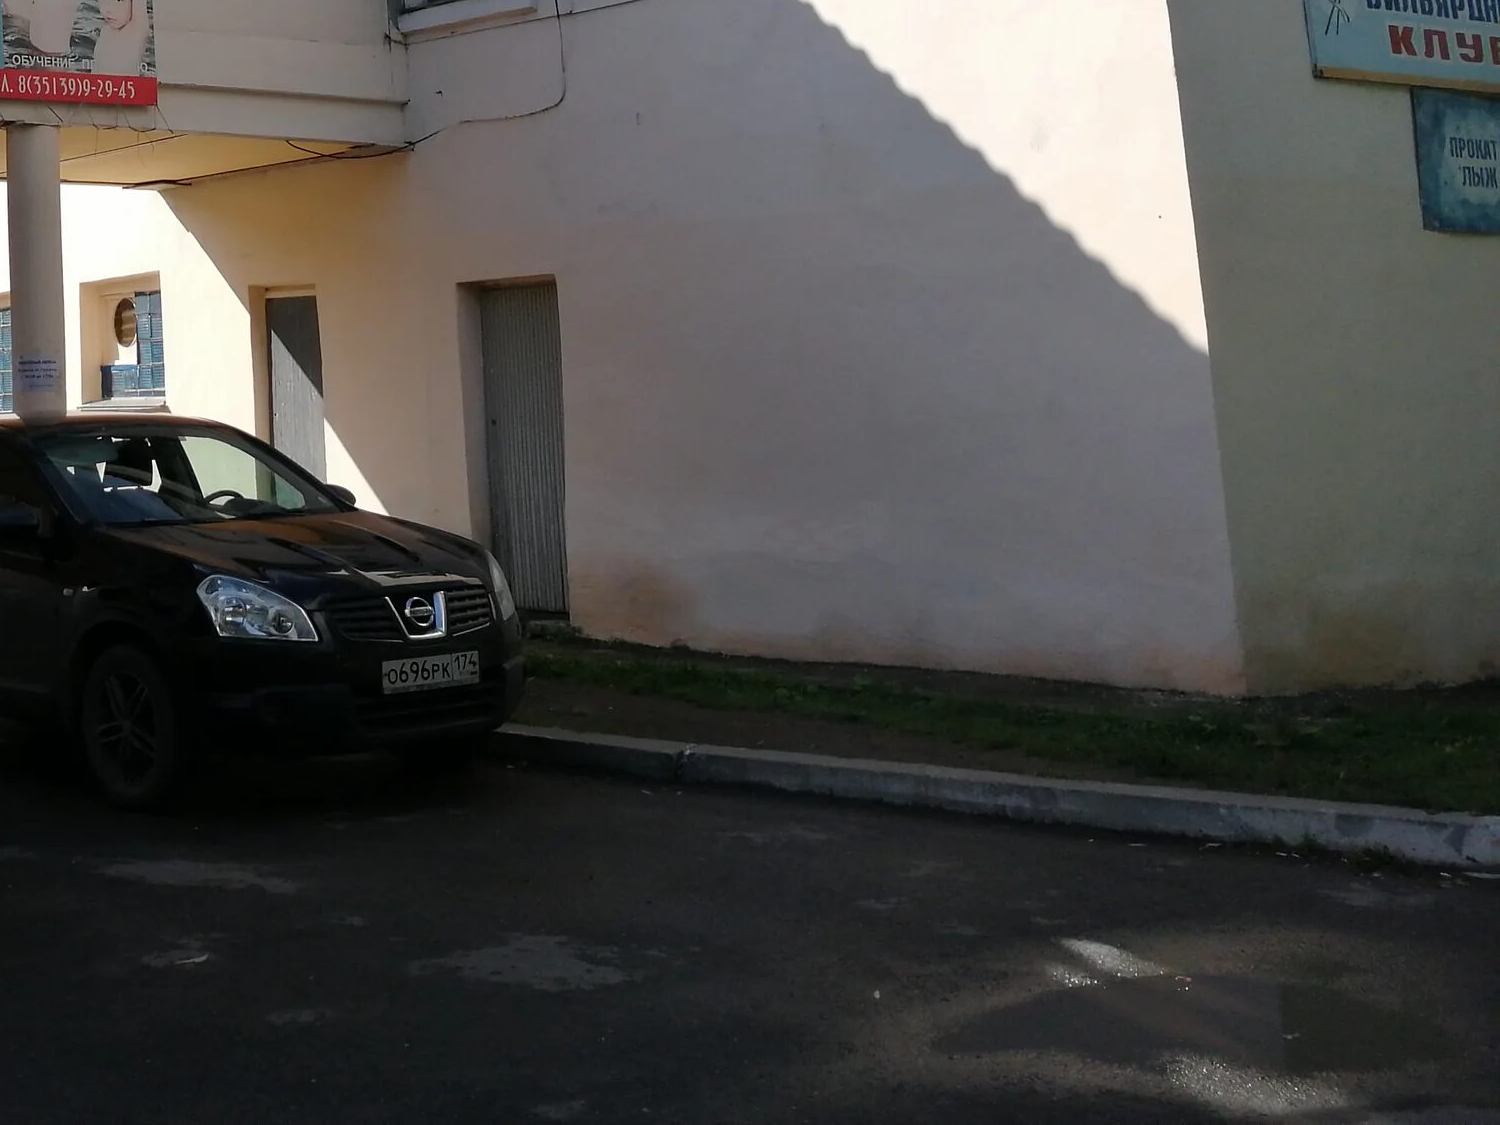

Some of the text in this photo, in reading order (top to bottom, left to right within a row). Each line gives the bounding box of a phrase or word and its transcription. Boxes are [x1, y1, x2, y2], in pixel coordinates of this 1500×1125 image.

[18, 74, 135, 99] 8(35139)9-29-45
[1449, 136, 1498, 161] ПРОКАТ
[1461, 166, 1499, 190] ЛЫЖ
